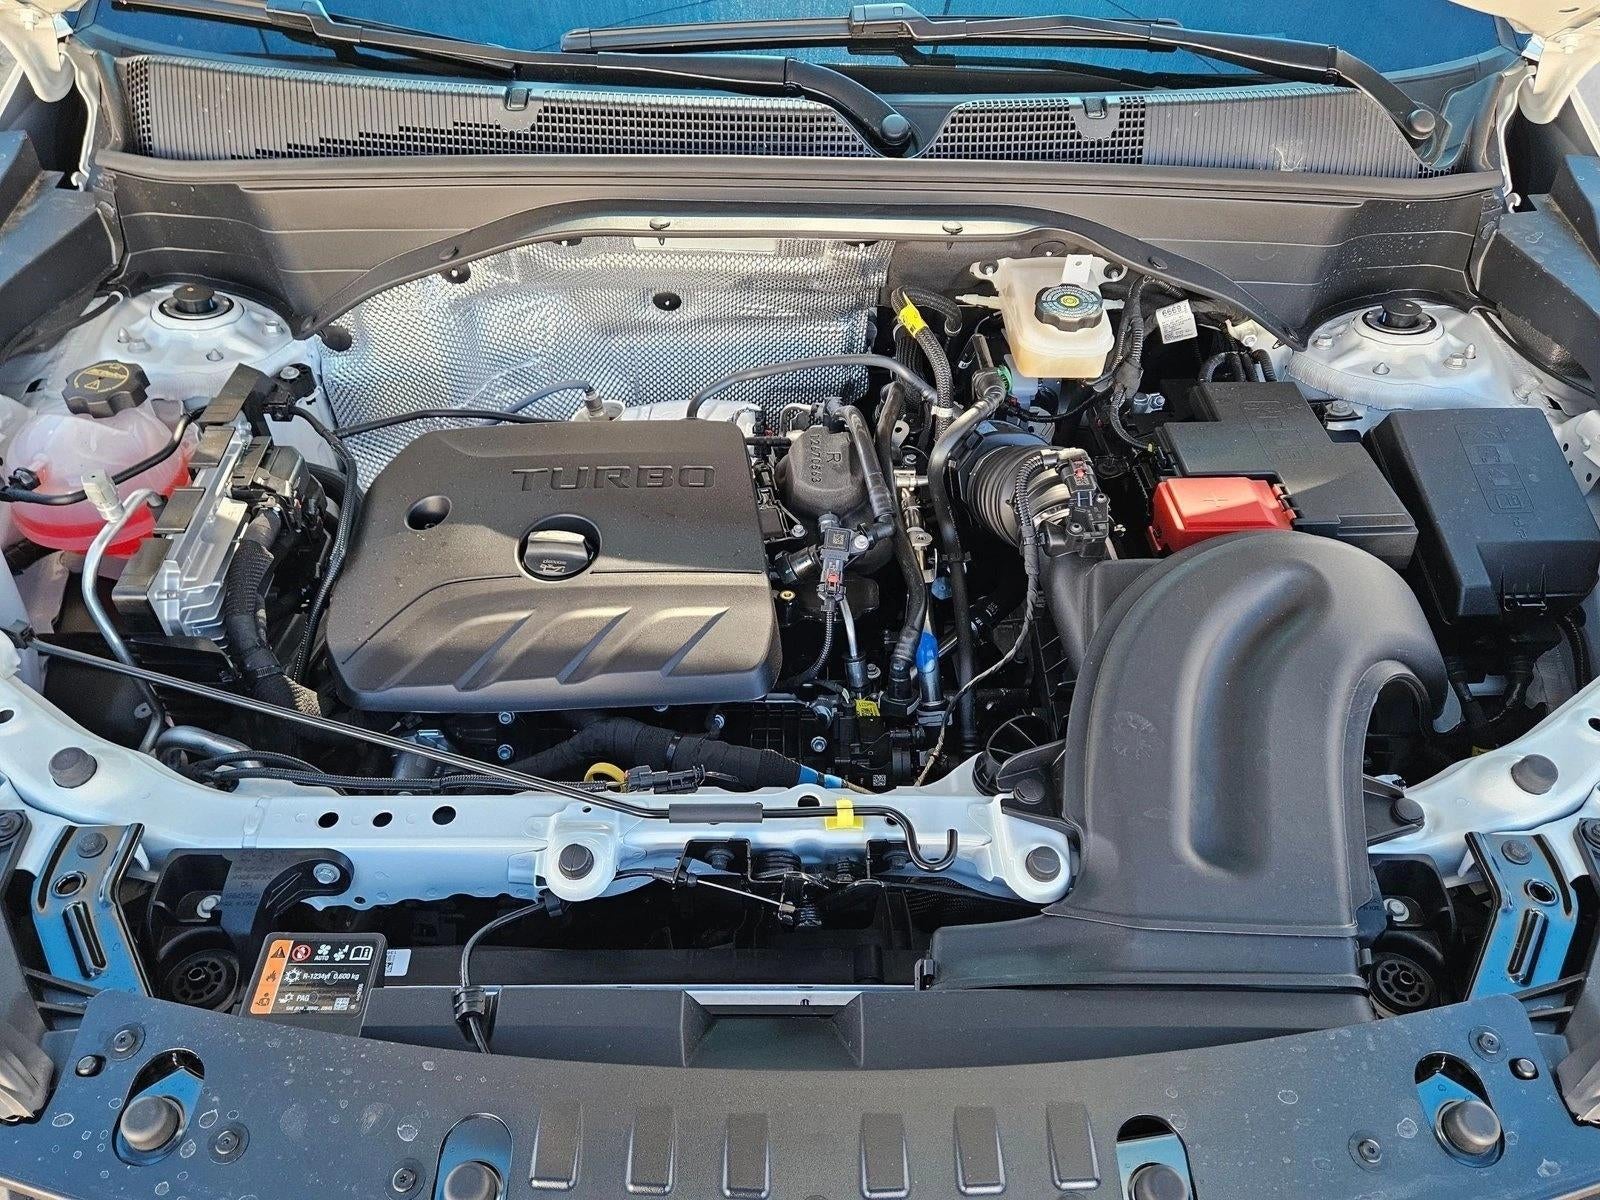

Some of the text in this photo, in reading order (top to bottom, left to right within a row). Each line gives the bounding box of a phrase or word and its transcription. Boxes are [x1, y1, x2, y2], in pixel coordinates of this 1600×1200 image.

[512, 464, 716, 492] TURBO
[302, 972, 331, 980] R-1234yf
[296, 994, 310, 1002] PAG
